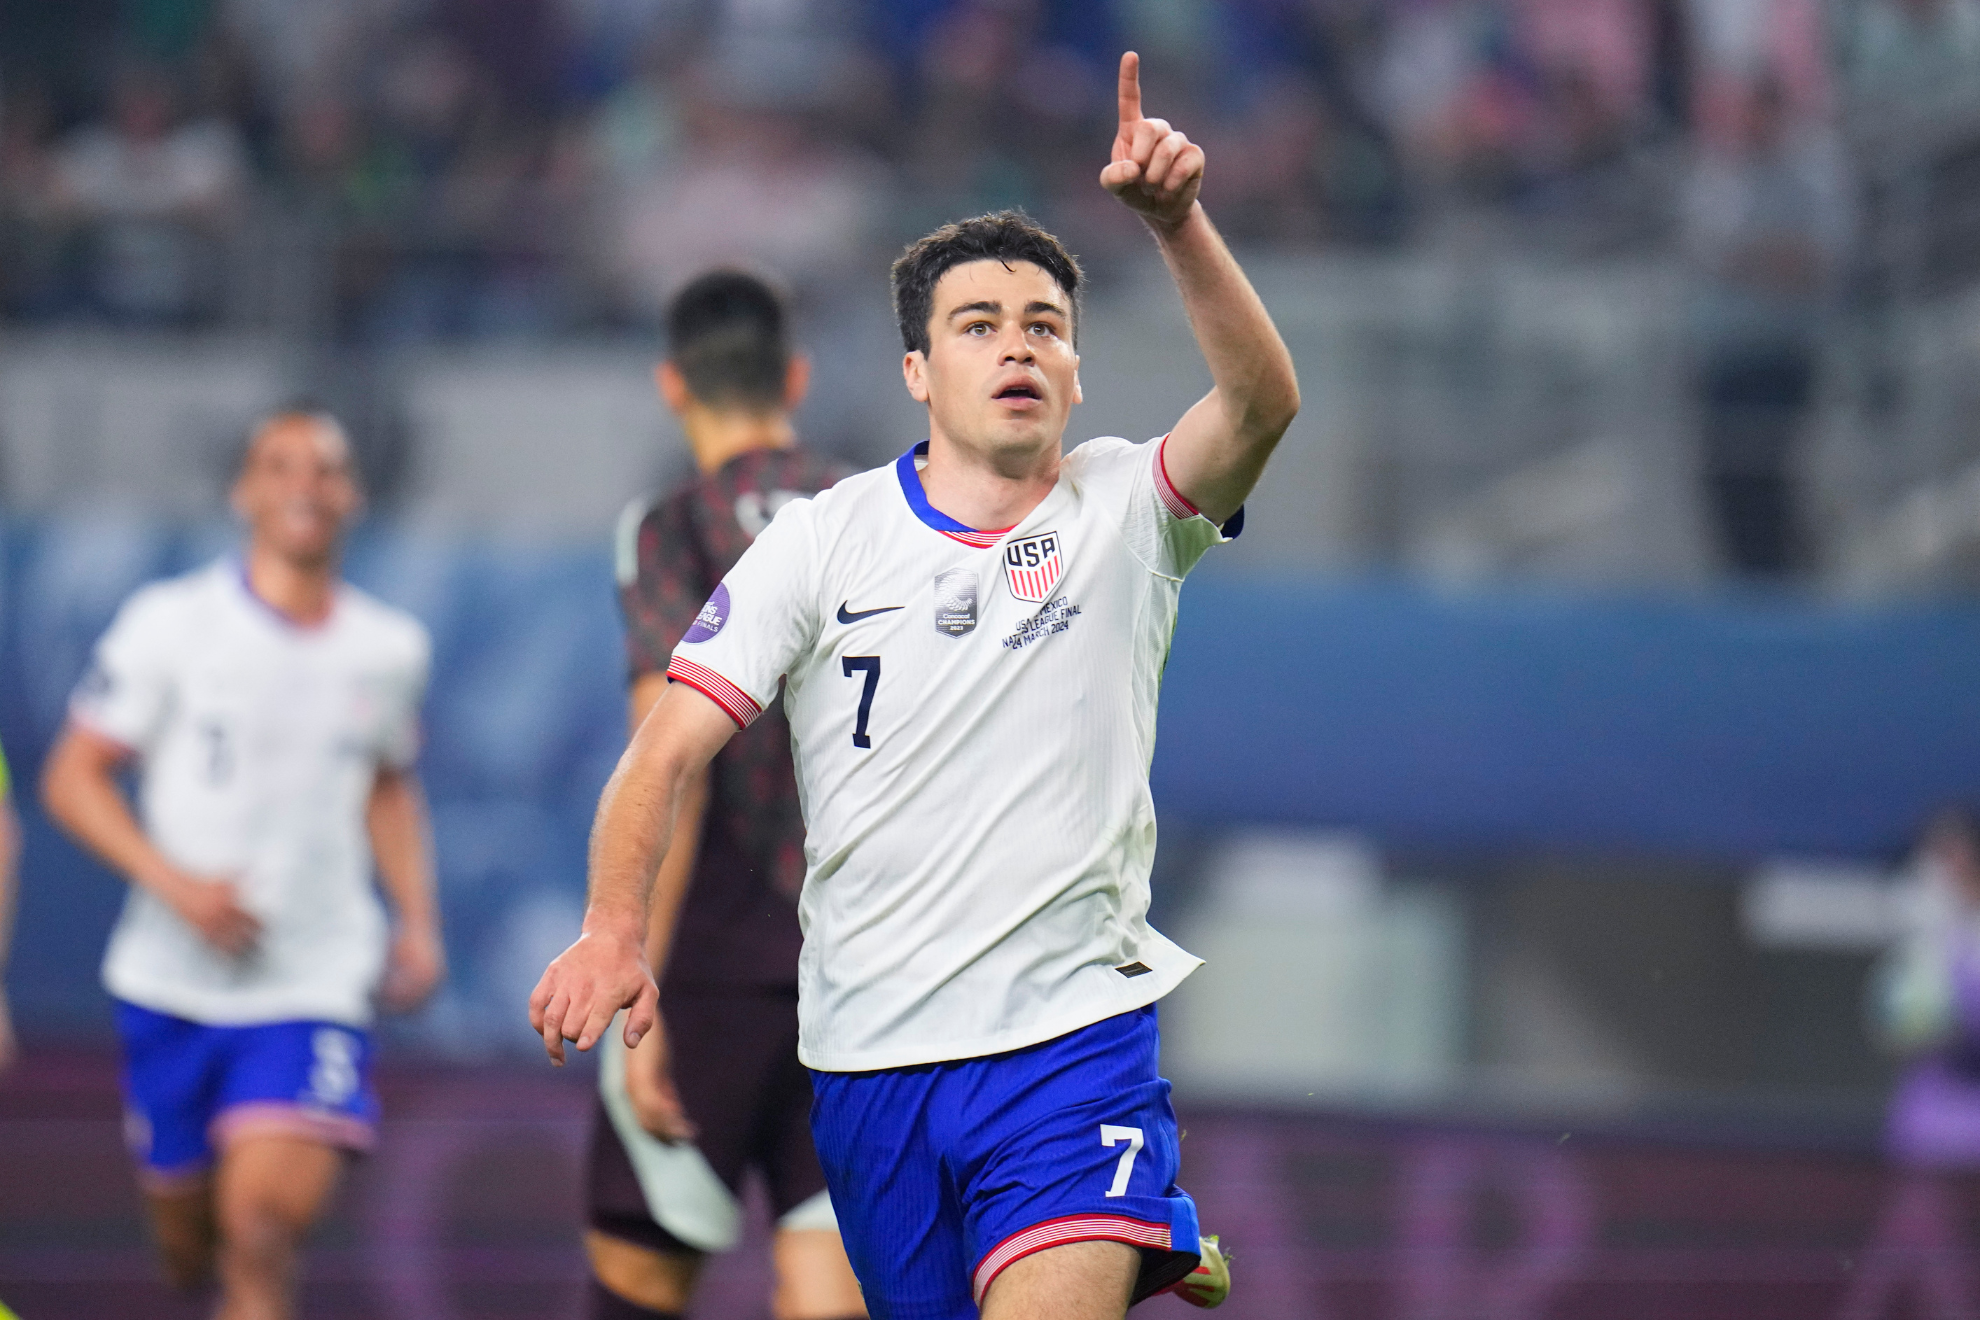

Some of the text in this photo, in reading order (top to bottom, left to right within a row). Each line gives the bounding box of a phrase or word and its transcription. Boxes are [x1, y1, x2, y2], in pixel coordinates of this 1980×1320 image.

[1007, 537, 1055, 567] USA
[1030, 611, 1059, 631] LEAGUE
[1061, 605, 1081, 619] FINAL
[1040, 596, 1068, 615] MEXICO
[697, 620, 718, 632] FINALS
[1023, 626, 1049, 646] MARCH
[1051, 620, 1069, 633] 2024
[842, 655, 880, 749] 7
[1100, 1123, 1144, 1197] 7
